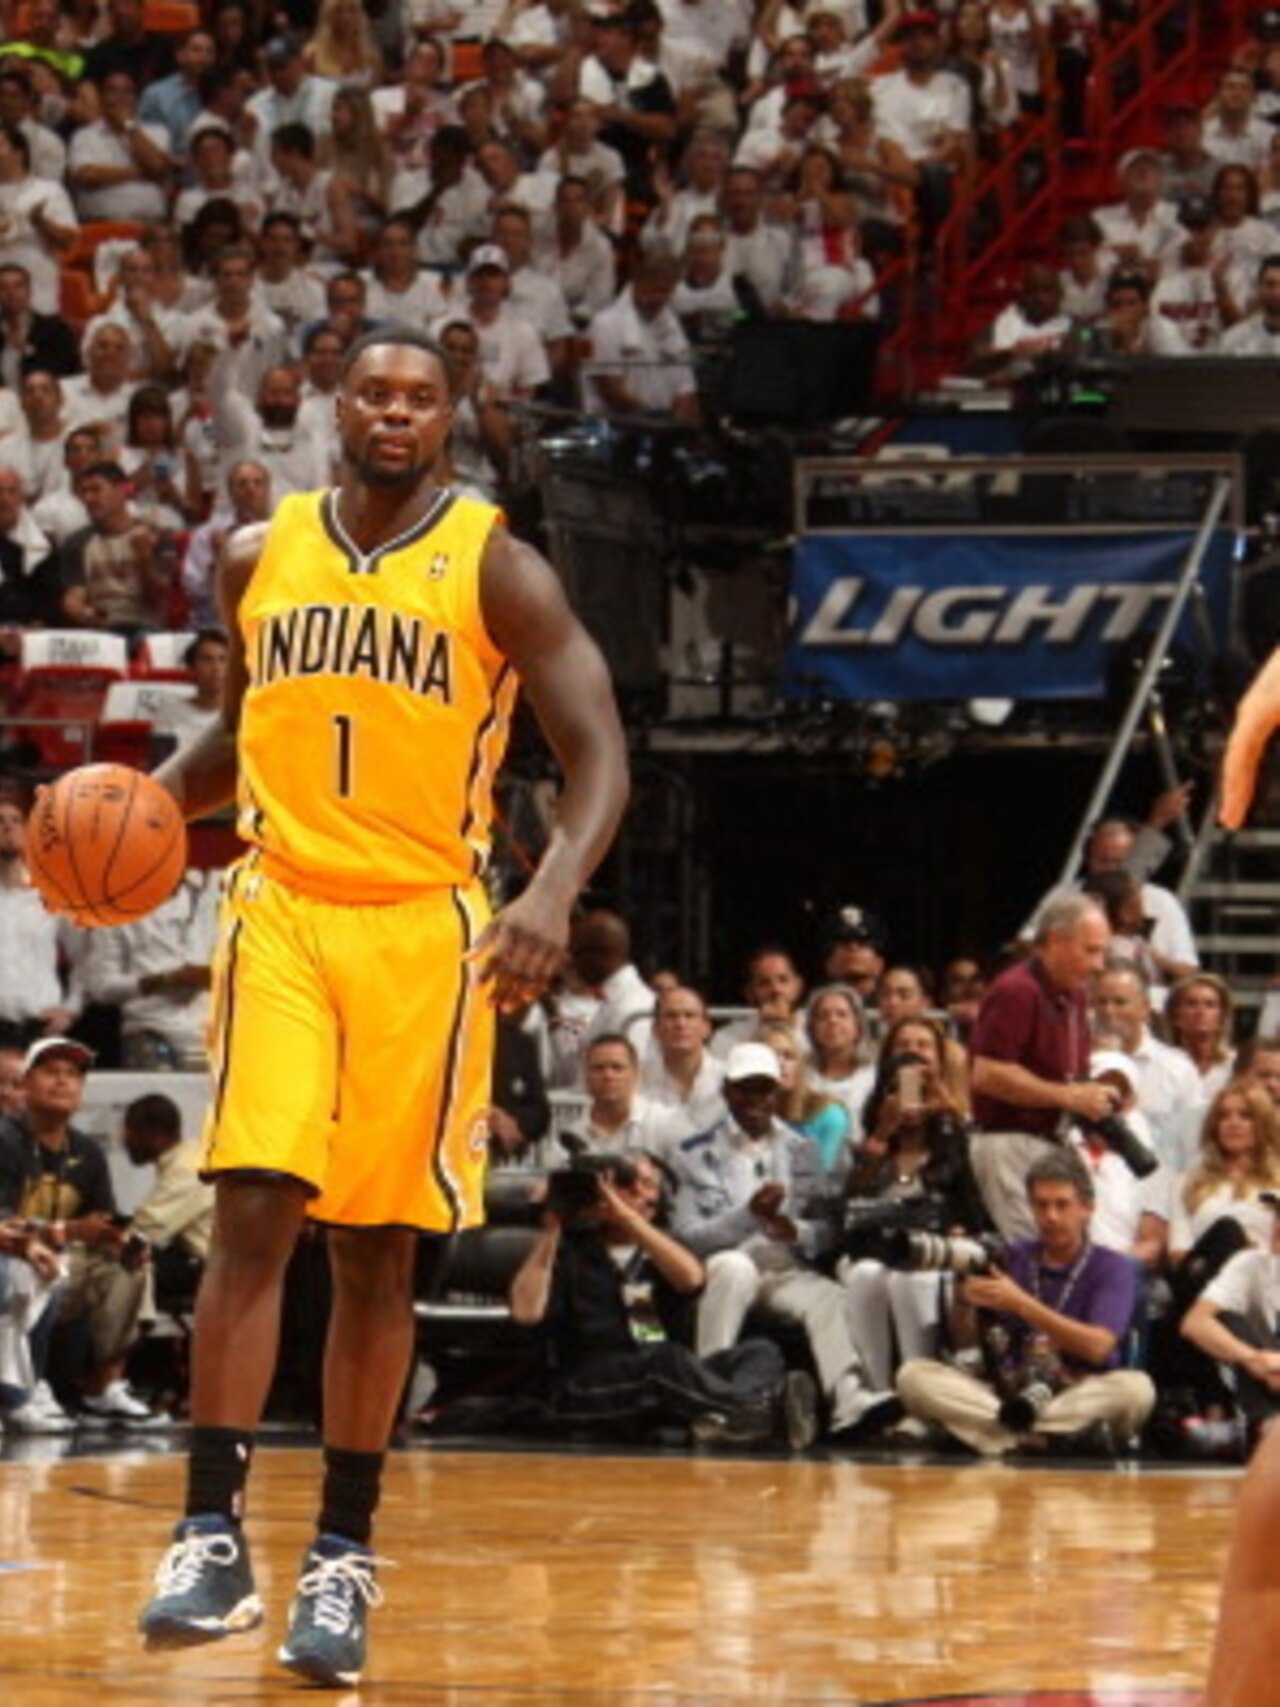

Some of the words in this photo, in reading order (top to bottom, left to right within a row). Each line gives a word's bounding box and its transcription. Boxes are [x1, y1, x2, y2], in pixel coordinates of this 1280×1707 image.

[801, 577, 1182, 645] LIGHT
[257, 605, 452, 705] INDIANA
[333, 714, 350, 798] 1
